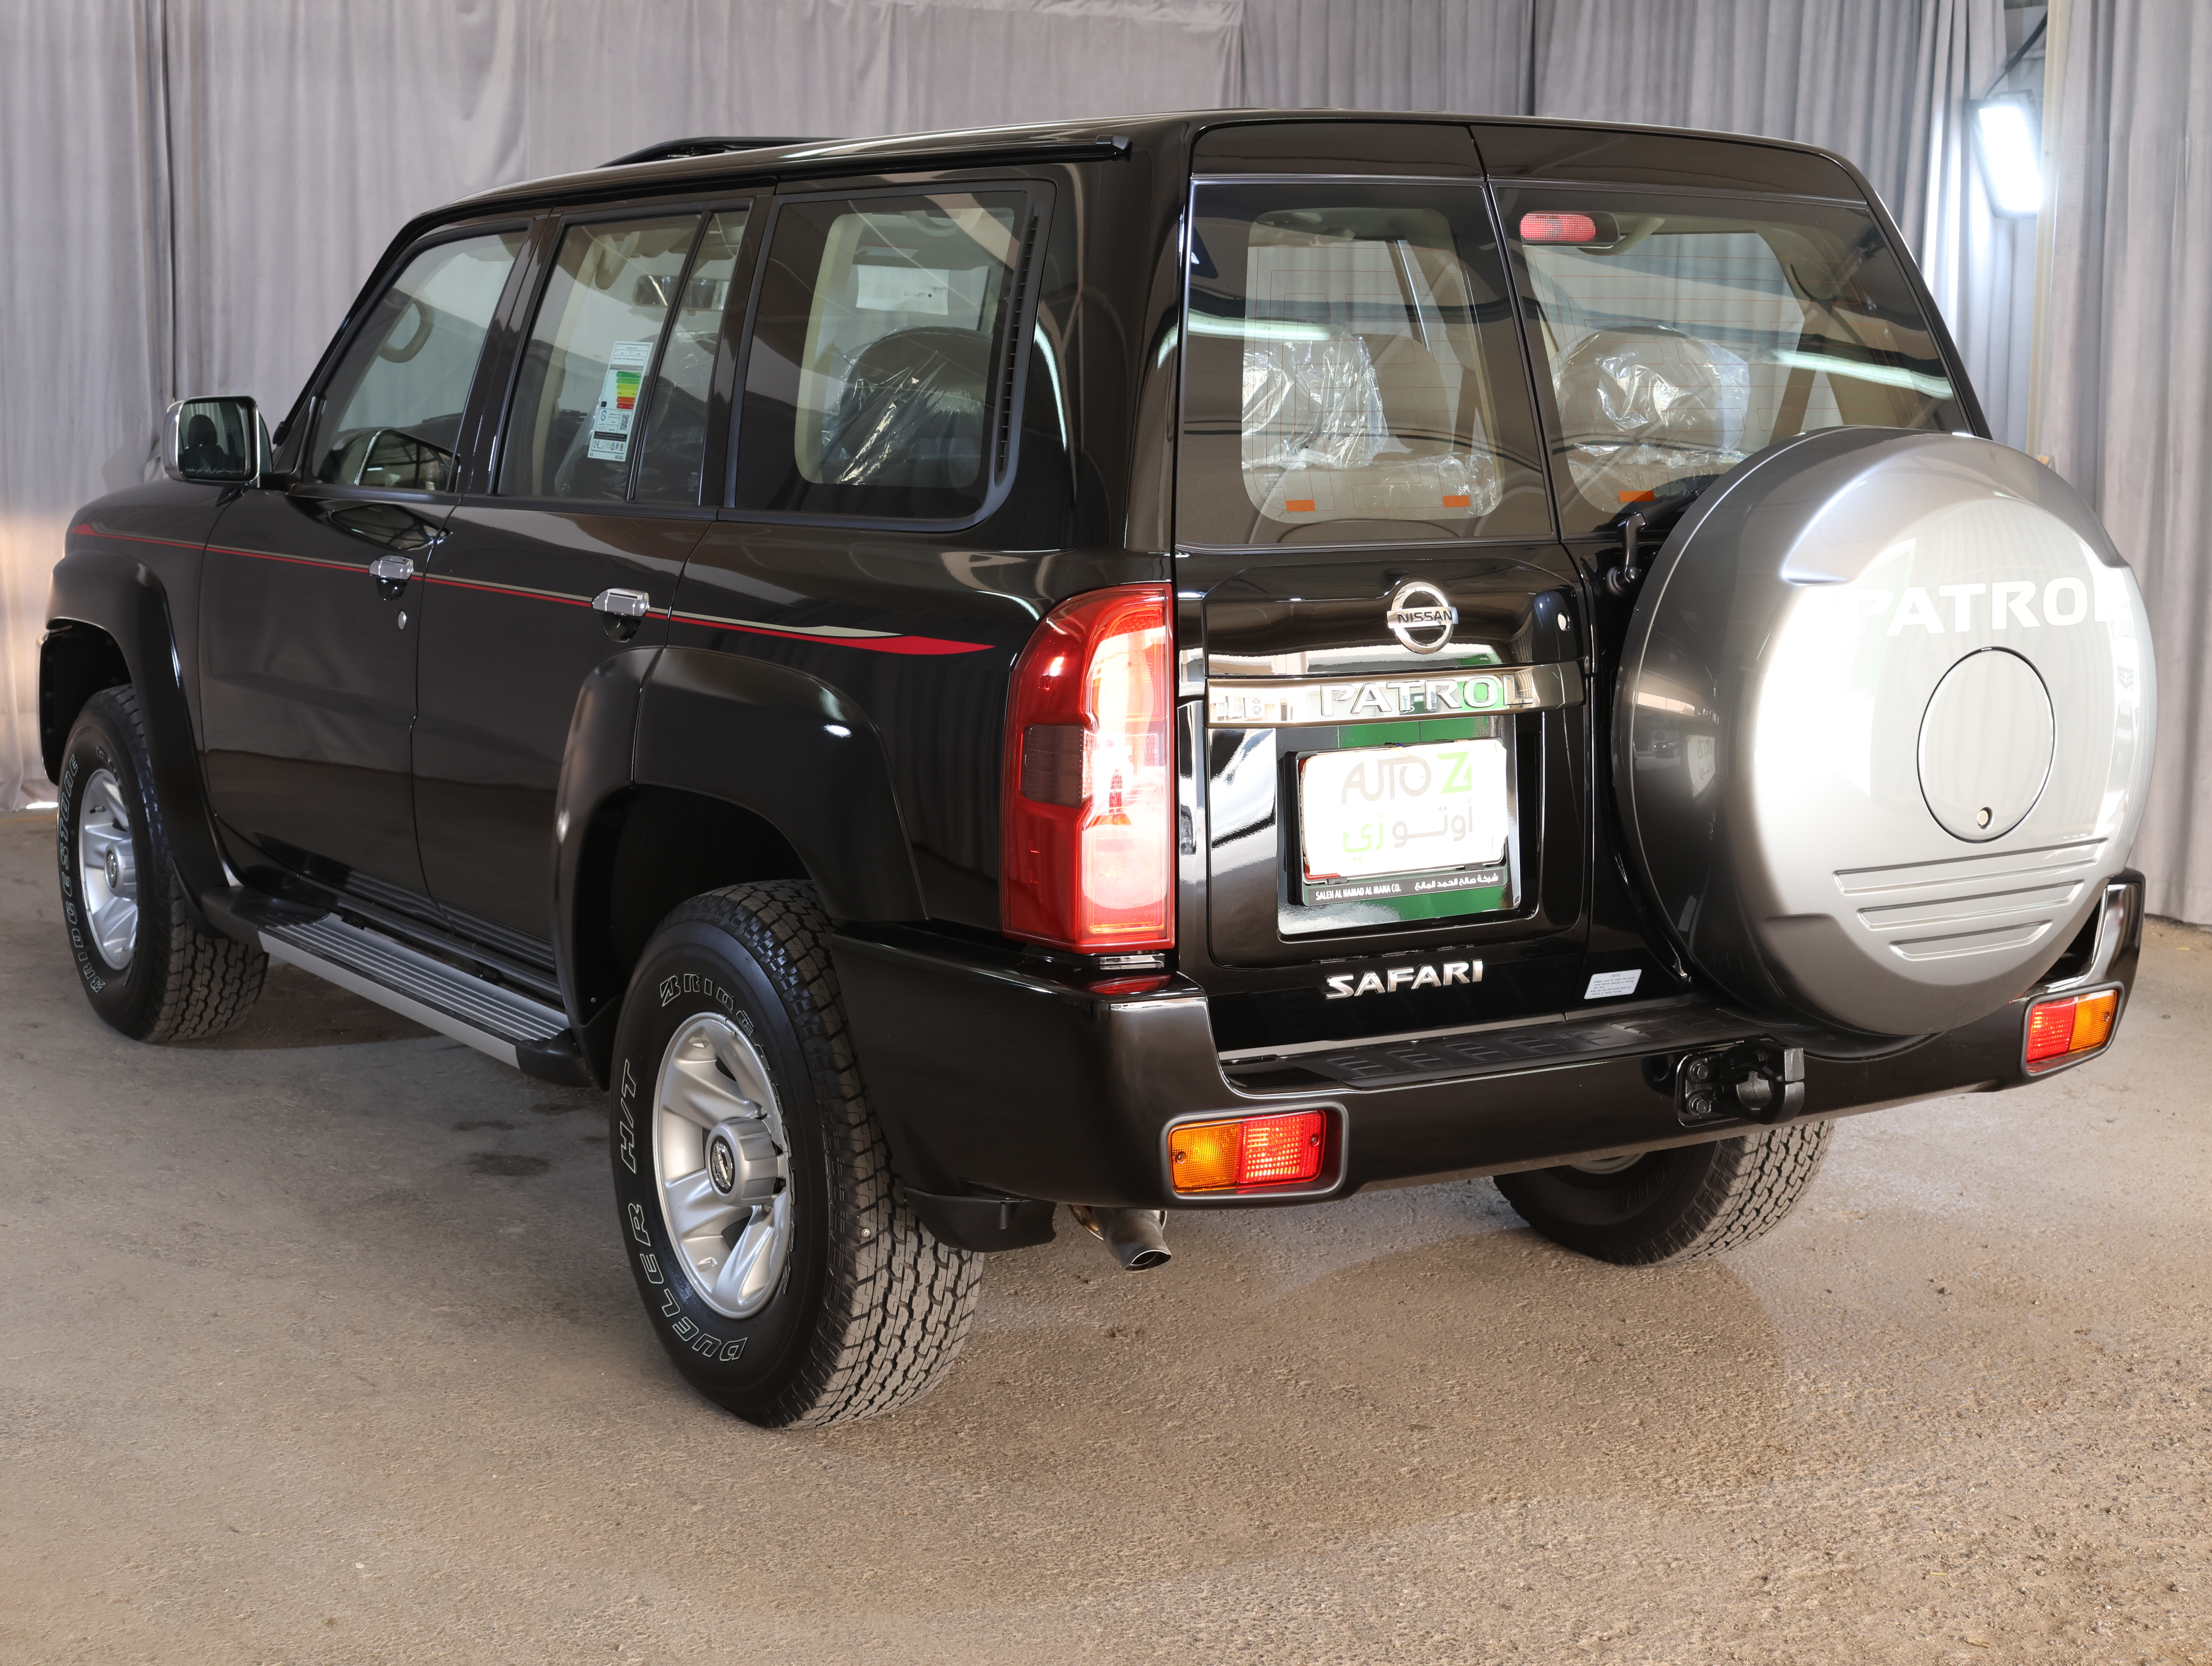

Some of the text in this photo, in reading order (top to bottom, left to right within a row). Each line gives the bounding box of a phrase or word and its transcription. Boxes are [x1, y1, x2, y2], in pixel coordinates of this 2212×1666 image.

[1397, 610, 1453, 624] NISSAN
[1320, 674, 1534, 716] PATROL
[1341, 755, 1431, 805] AUTO
[60, 753, 106, 993] BRIDGESTONE
[1315, 884, 1401, 901] SALEH AL HAMAD AL MANA CO.
[1414, 872, 1499, 891] شركة صالح الحمد المانع
[1325, 959, 1483, 1000] SAFARI
[621, 1058, 638, 1174] H/T
[628, 1203, 748, 1362] DUELER
